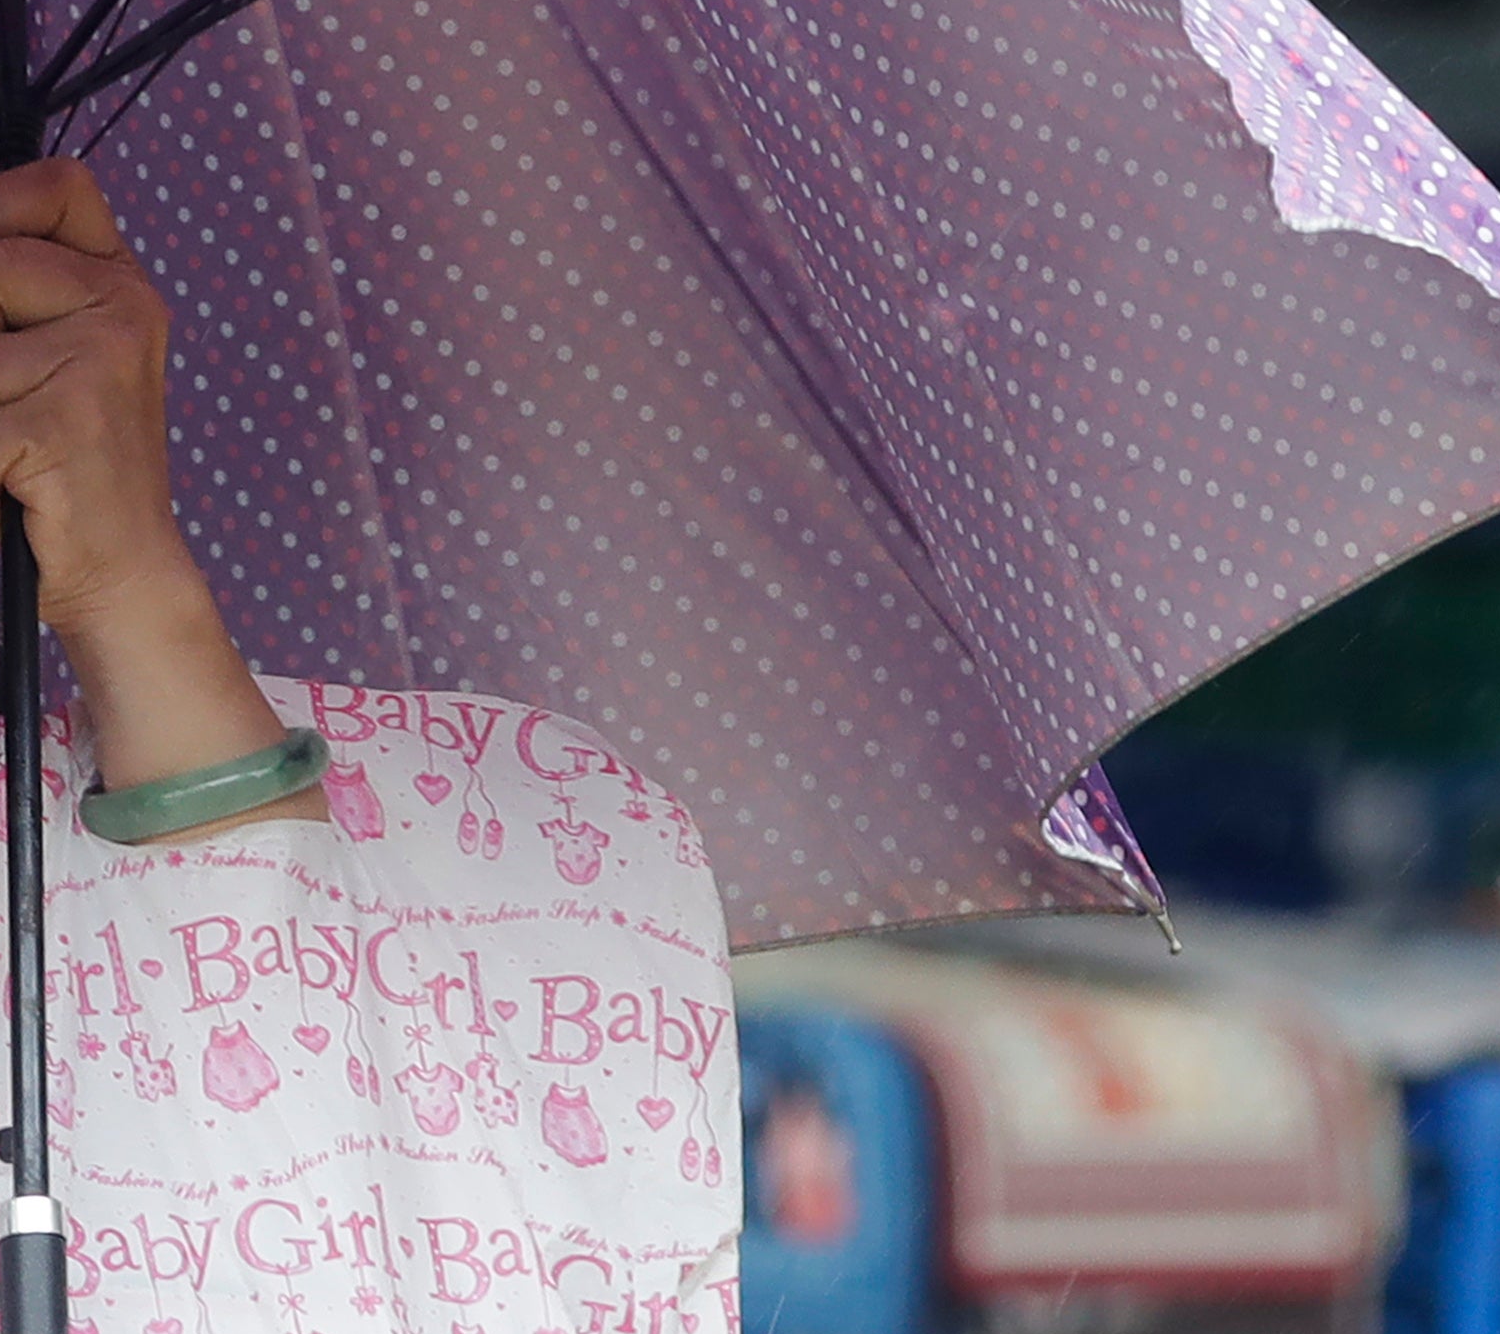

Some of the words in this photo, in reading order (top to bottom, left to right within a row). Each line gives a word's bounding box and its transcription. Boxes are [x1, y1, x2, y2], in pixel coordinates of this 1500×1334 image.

[296, 679, 505, 766] Baby
[195, 846, 278, 872] Fashion
[286, 858, 323, 896] Shop
[458, 901, 541, 928] Fashion
[547, 898, 602, 927] Shop
[634, 916, 707, 959] Fashion
[8, 919, 144, 1017] irl
[171, 915, 360, 1014] Baby
[528, 974, 731, 1079] Baby
[81, 1163, 165, 1192] Fashion
[171, 1179, 220, 1209] Shop
[257, 1149, 329, 1188] Fashion
[234, 1183, 402, 1280] Girl
